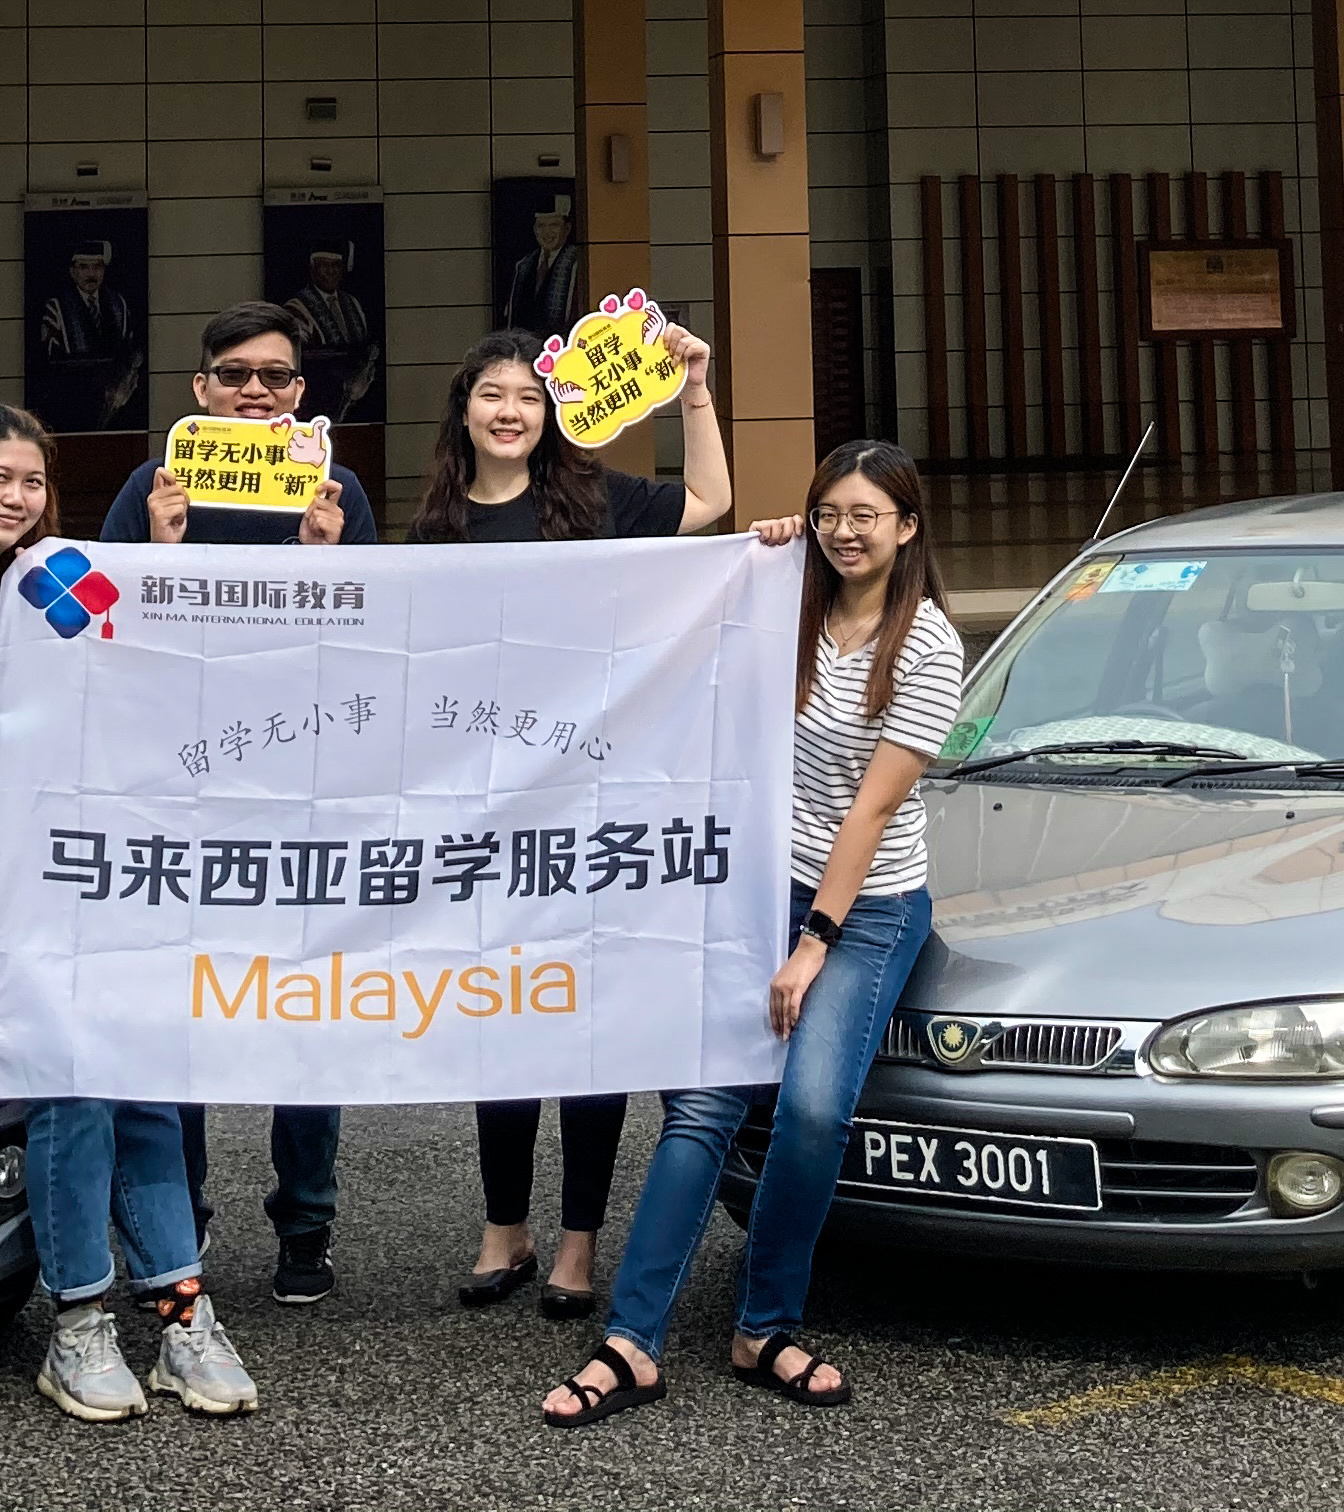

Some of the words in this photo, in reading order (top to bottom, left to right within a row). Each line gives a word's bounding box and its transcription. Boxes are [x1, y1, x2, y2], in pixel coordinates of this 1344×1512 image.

[585, 333, 623, 369] 留学
[588, 348, 643, 396] 无小事
[174, 439, 286, 466] 留学无小事
[141, 575, 366, 609] 新马国际教育
[141, 611, 163, 621] XIN
[166, 613, 188, 622] MA
[192, 614, 291, 626] INTERNATIONAL
[294, 617, 365, 626] EDUCATION
[177, 692, 377, 778] 留学无小事
[430, 694, 612, 762] 当然更用心
[42, 814, 732, 906] 马来西亚留学服务站
[191, 946, 578, 1039] Malaysia
[864, 1131, 941, 1183] PEX
[954, 1141, 1050, 1196] 3001
